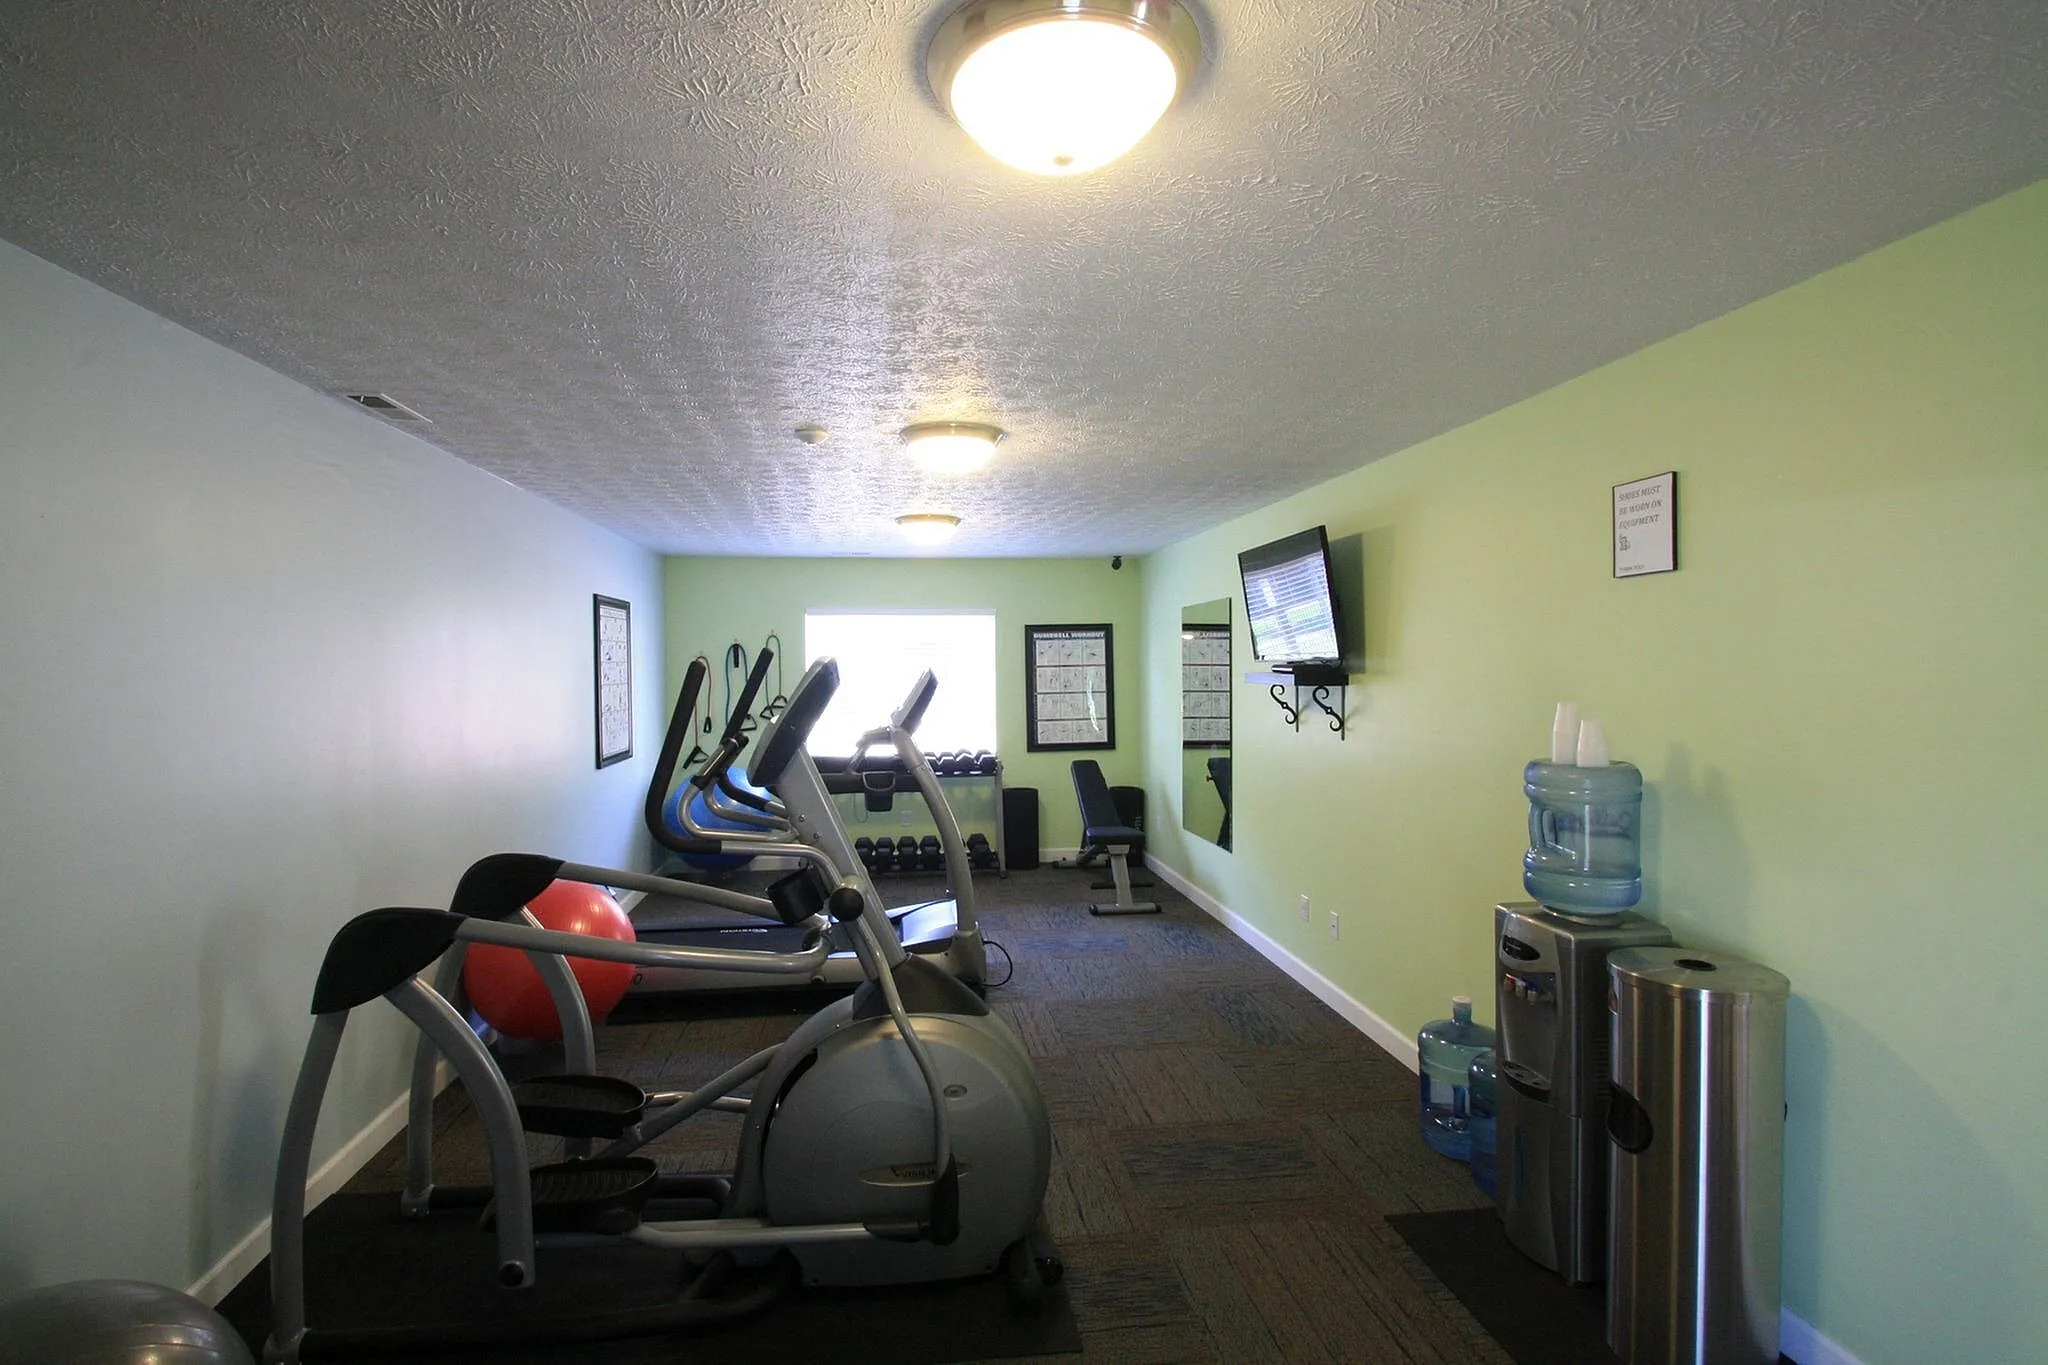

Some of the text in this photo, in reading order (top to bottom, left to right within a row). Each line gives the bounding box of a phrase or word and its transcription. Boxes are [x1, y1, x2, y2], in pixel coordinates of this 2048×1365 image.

[1618, 485, 1662, 502] SHOES MUST
[1618, 499, 1662, 516] BE WORN ON
[1618, 514, 1661, 529] EQUIPMENT
